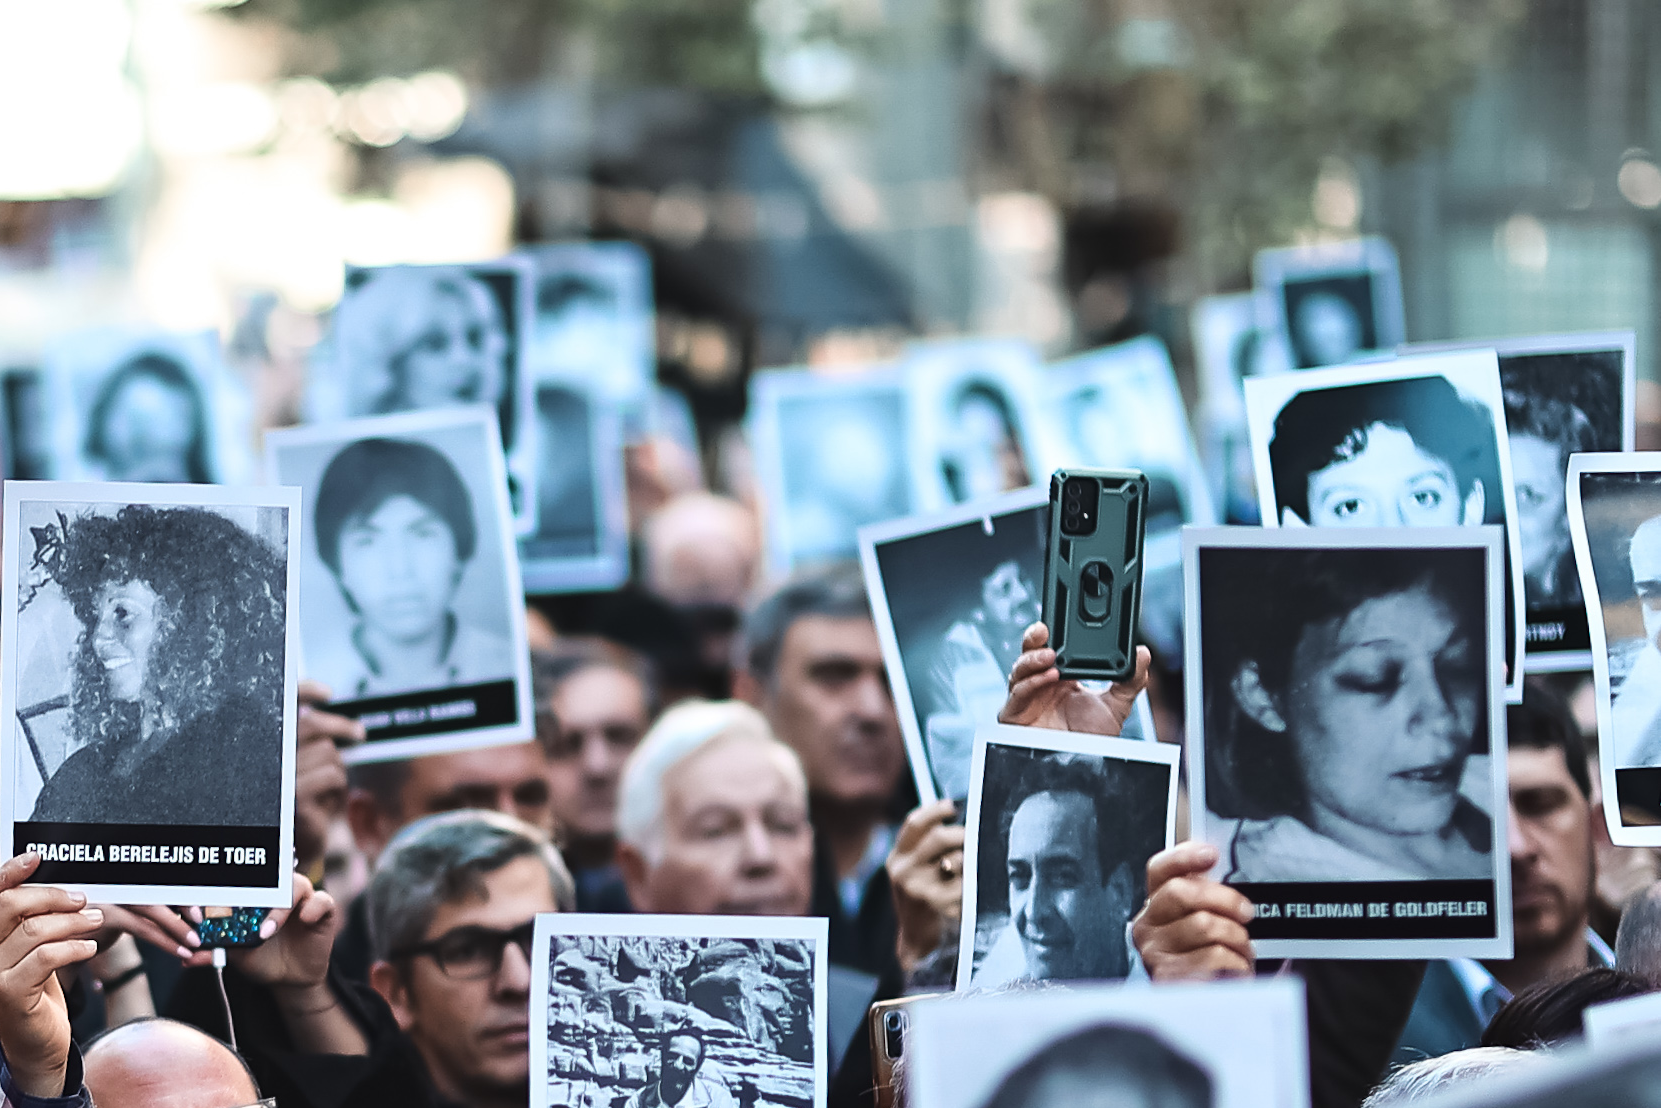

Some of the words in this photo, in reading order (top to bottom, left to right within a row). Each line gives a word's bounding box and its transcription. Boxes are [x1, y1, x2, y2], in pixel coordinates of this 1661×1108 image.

[109, 845, 195, 864] BERELEJIS
[198, 847, 220, 864] DE
[224, 847, 267, 866] TOER
[1254, 903, 1281, 918] ICA
[1286, 902, 1363, 918] FELDMAN
[1367, 902, 1390, 918] DE
